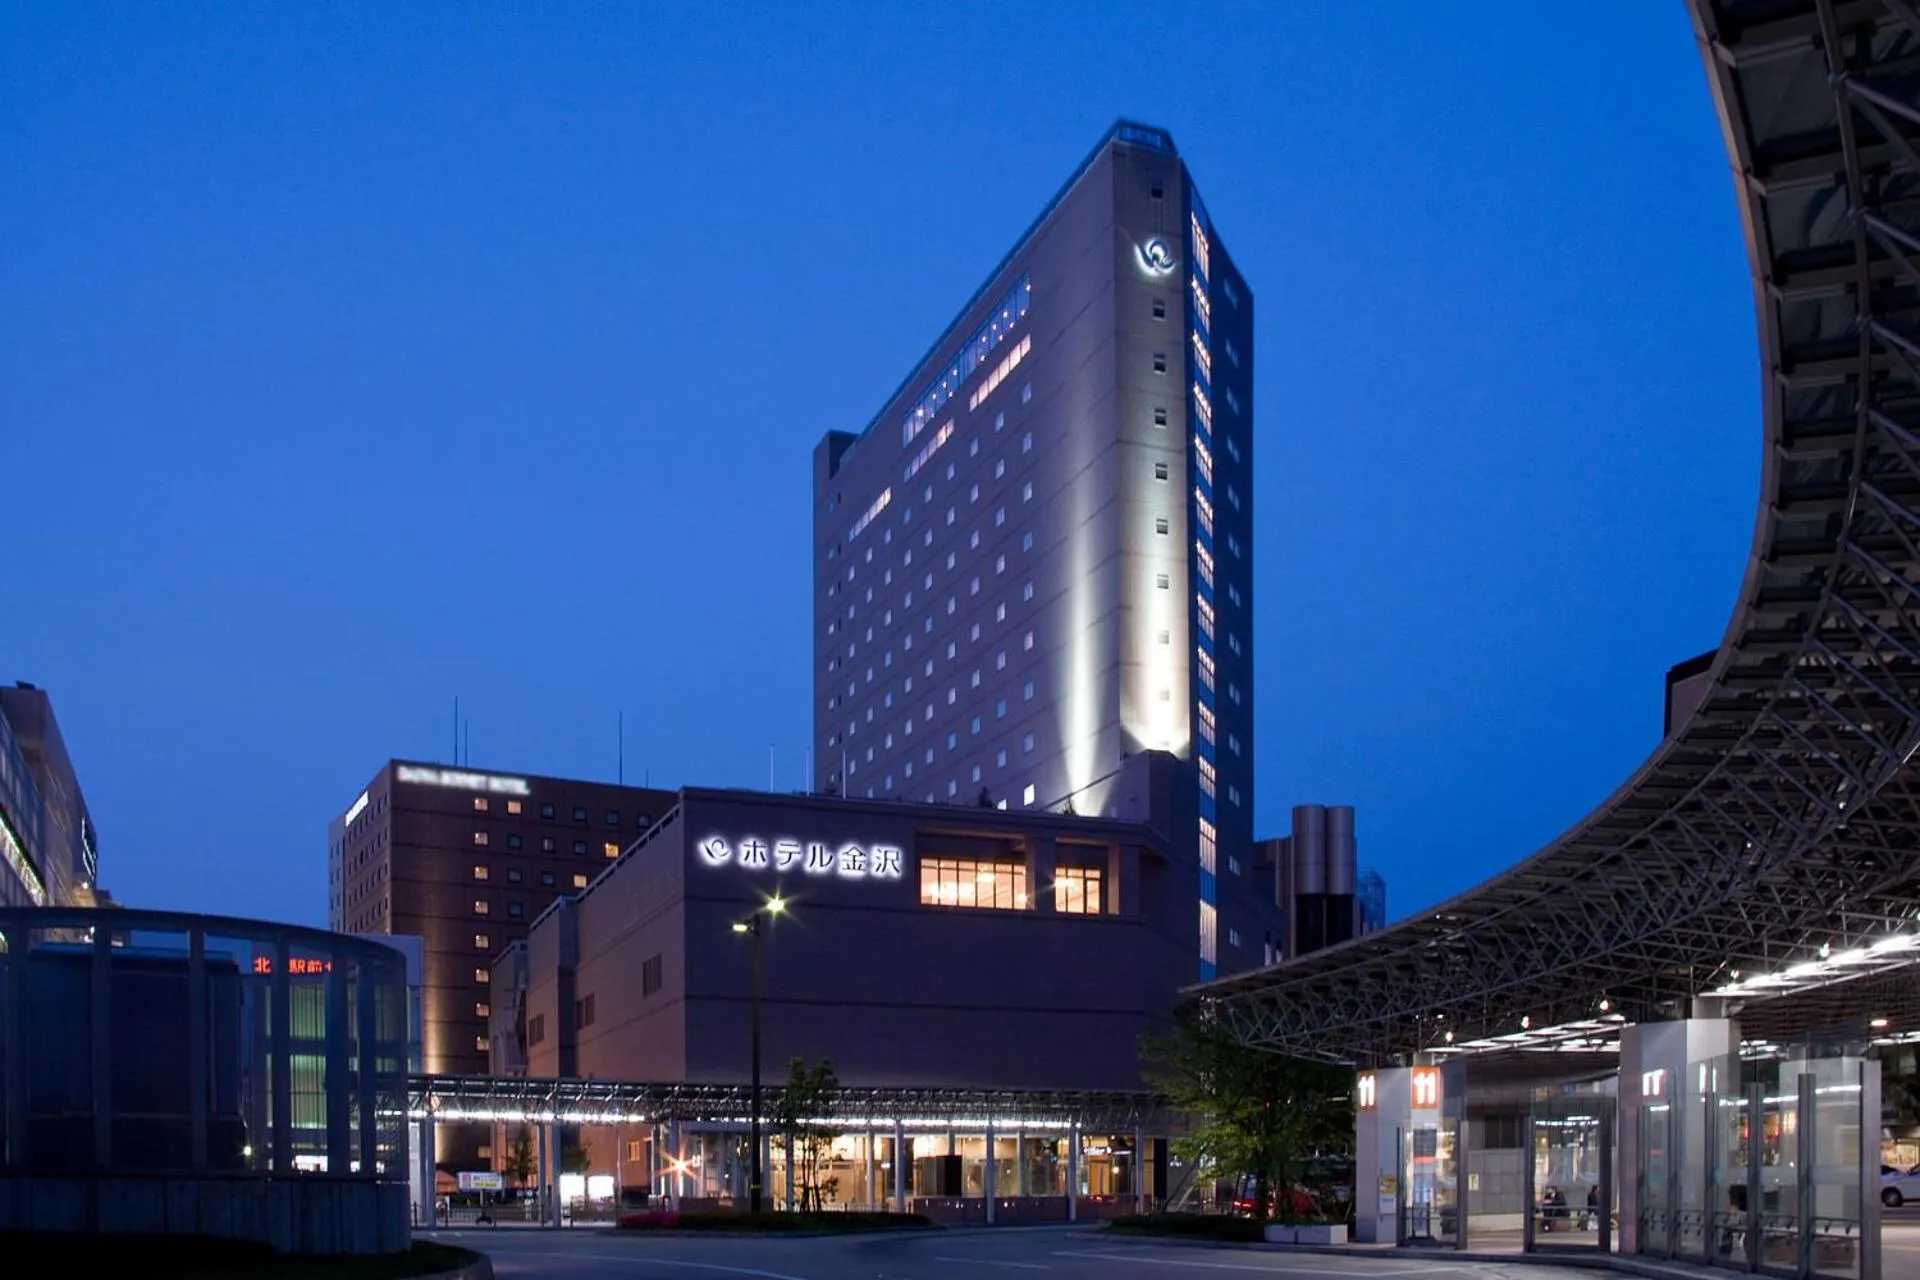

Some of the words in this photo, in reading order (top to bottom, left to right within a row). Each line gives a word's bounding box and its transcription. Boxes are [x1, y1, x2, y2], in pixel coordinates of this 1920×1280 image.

[741, 840, 901, 875] ホテル金沢
[1358, 1074, 1375, 1107] 11
[1413, 1071, 1436, 1105] 11
